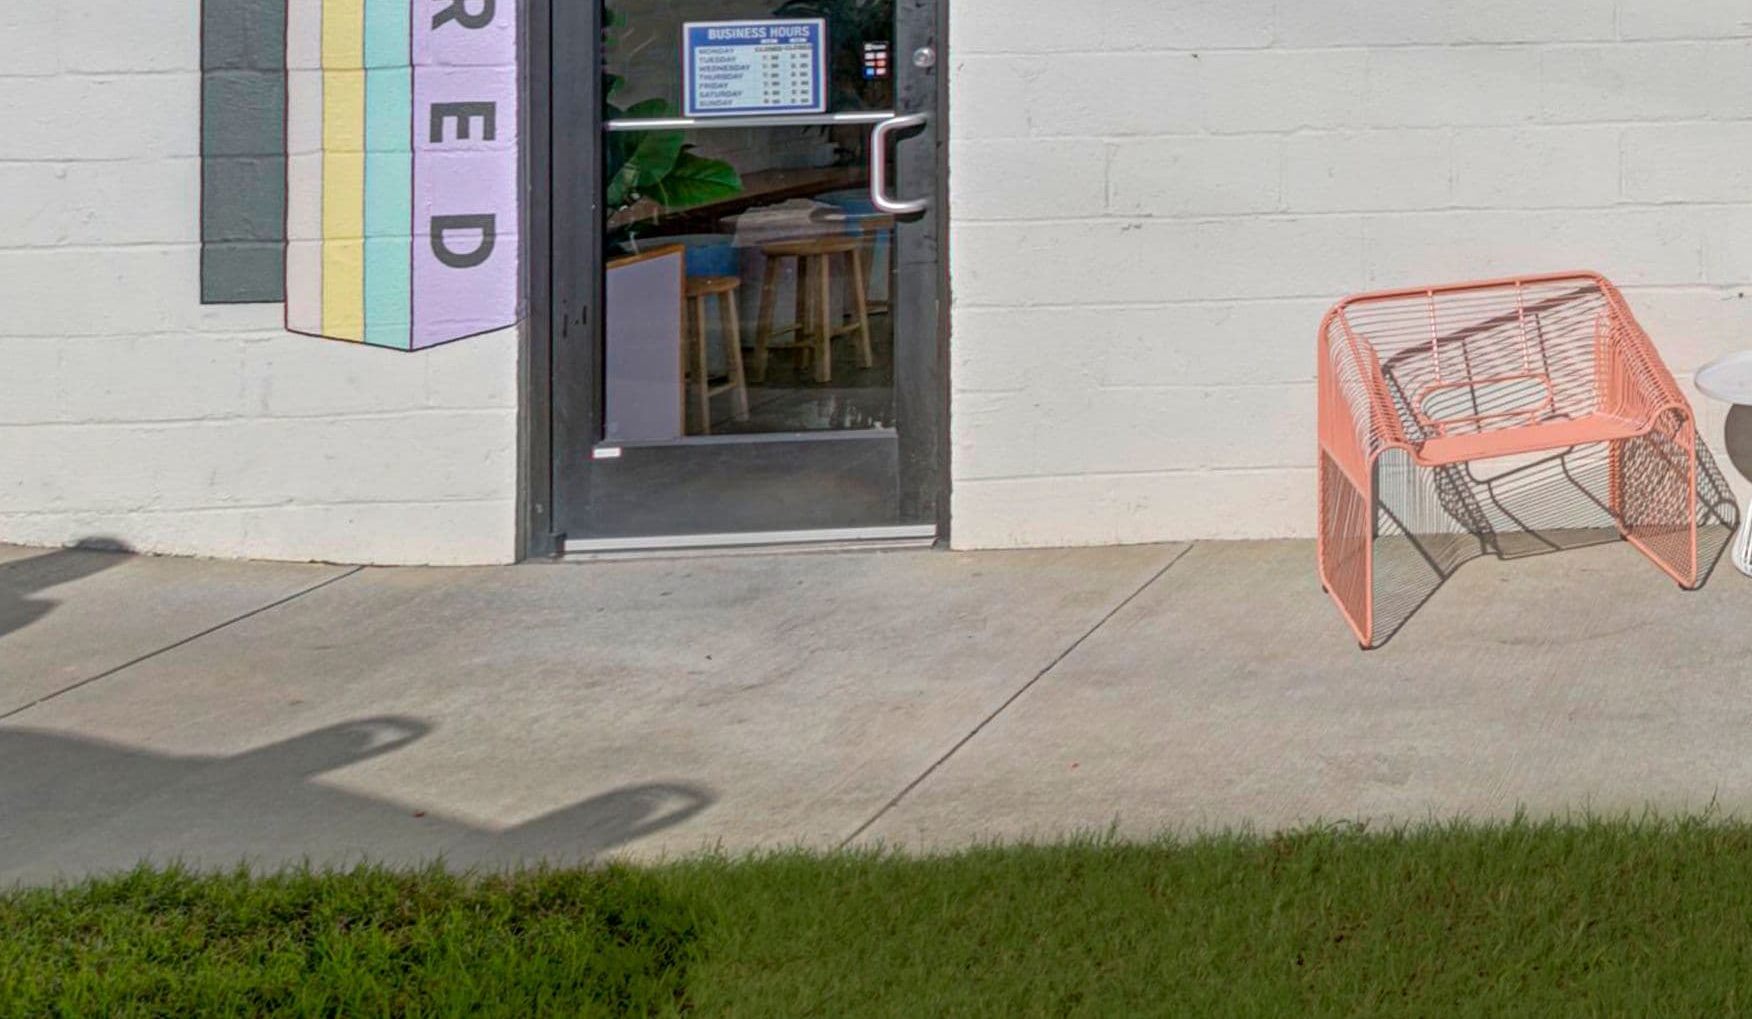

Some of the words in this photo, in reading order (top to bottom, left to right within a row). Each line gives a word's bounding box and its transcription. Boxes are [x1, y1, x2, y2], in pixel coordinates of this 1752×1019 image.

[708, 27, 767, 40] BUSINESS
[769, 26, 811, 37] HOURS
[699, 64, 751, 72] WEDNESDAY
[699, 90, 744, 98] SATURDAY
